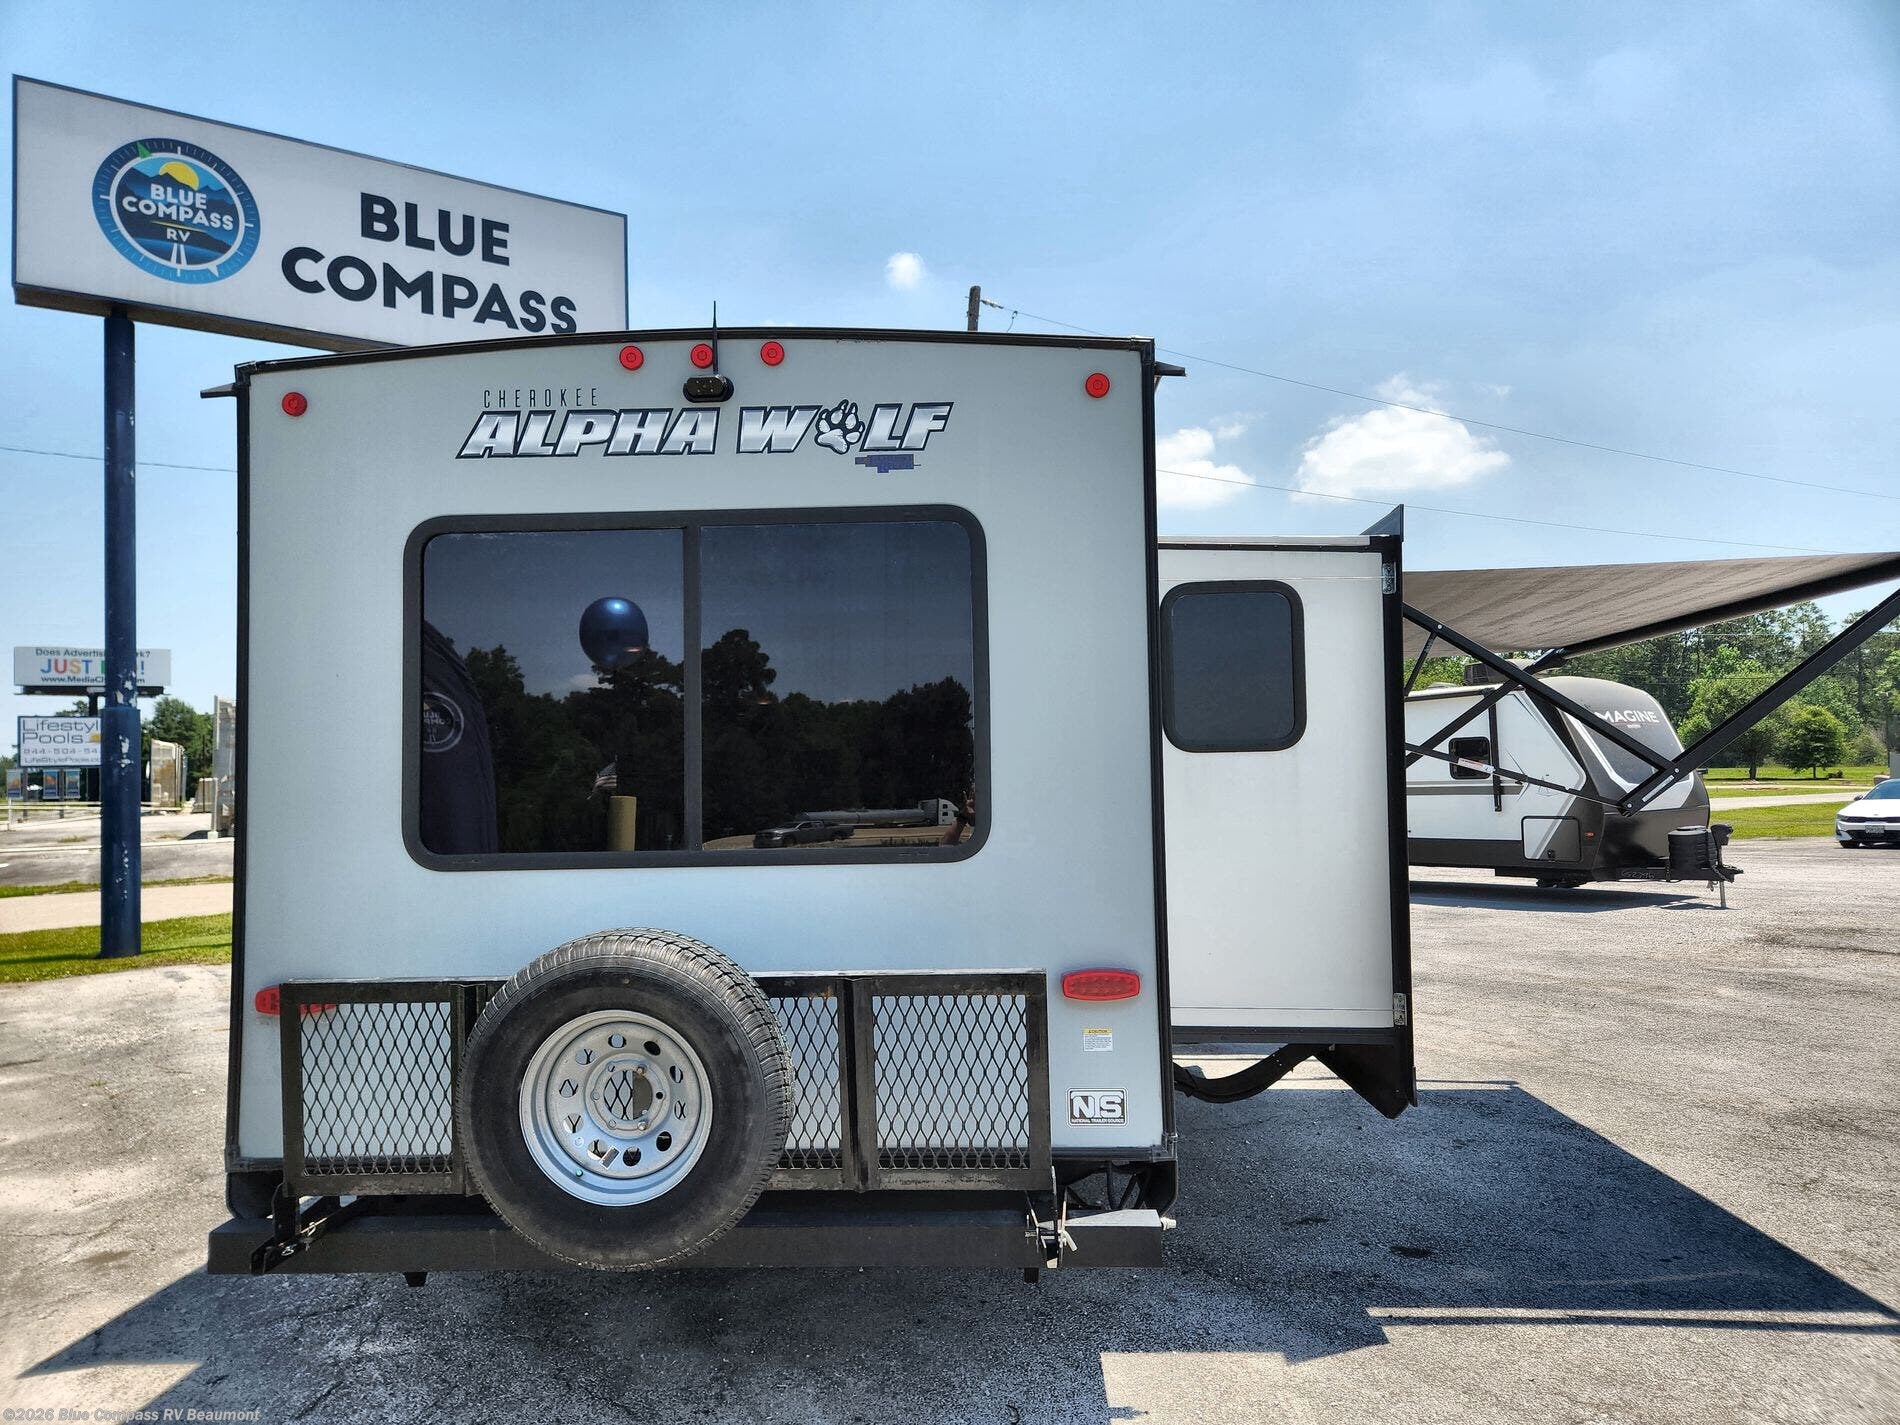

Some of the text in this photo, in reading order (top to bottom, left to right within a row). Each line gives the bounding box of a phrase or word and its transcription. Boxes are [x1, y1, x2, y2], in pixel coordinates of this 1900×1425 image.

[151, 183, 207, 210] BLUE
[122, 195, 234, 231] COMPASS
[166, 228, 190, 242] RV
[360, 191, 510, 266] BLUE
[281, 246, 577, 334] COMPASS
[484, 388, 598, 408] CHEROKEE
[455, 407, 720, 459] ALPHA
[35, 648, 61, 657] Does
[63, 649, 106, 658] Advertis
[41, 659, 92, 674] JUST
[22, 719, 99, 734] Lifestyl
[1594, 710, 1660, 723] MAGINE
[22, 732, 84, 744] Pools
[1071, 1091, 1125, 1118] NTS
